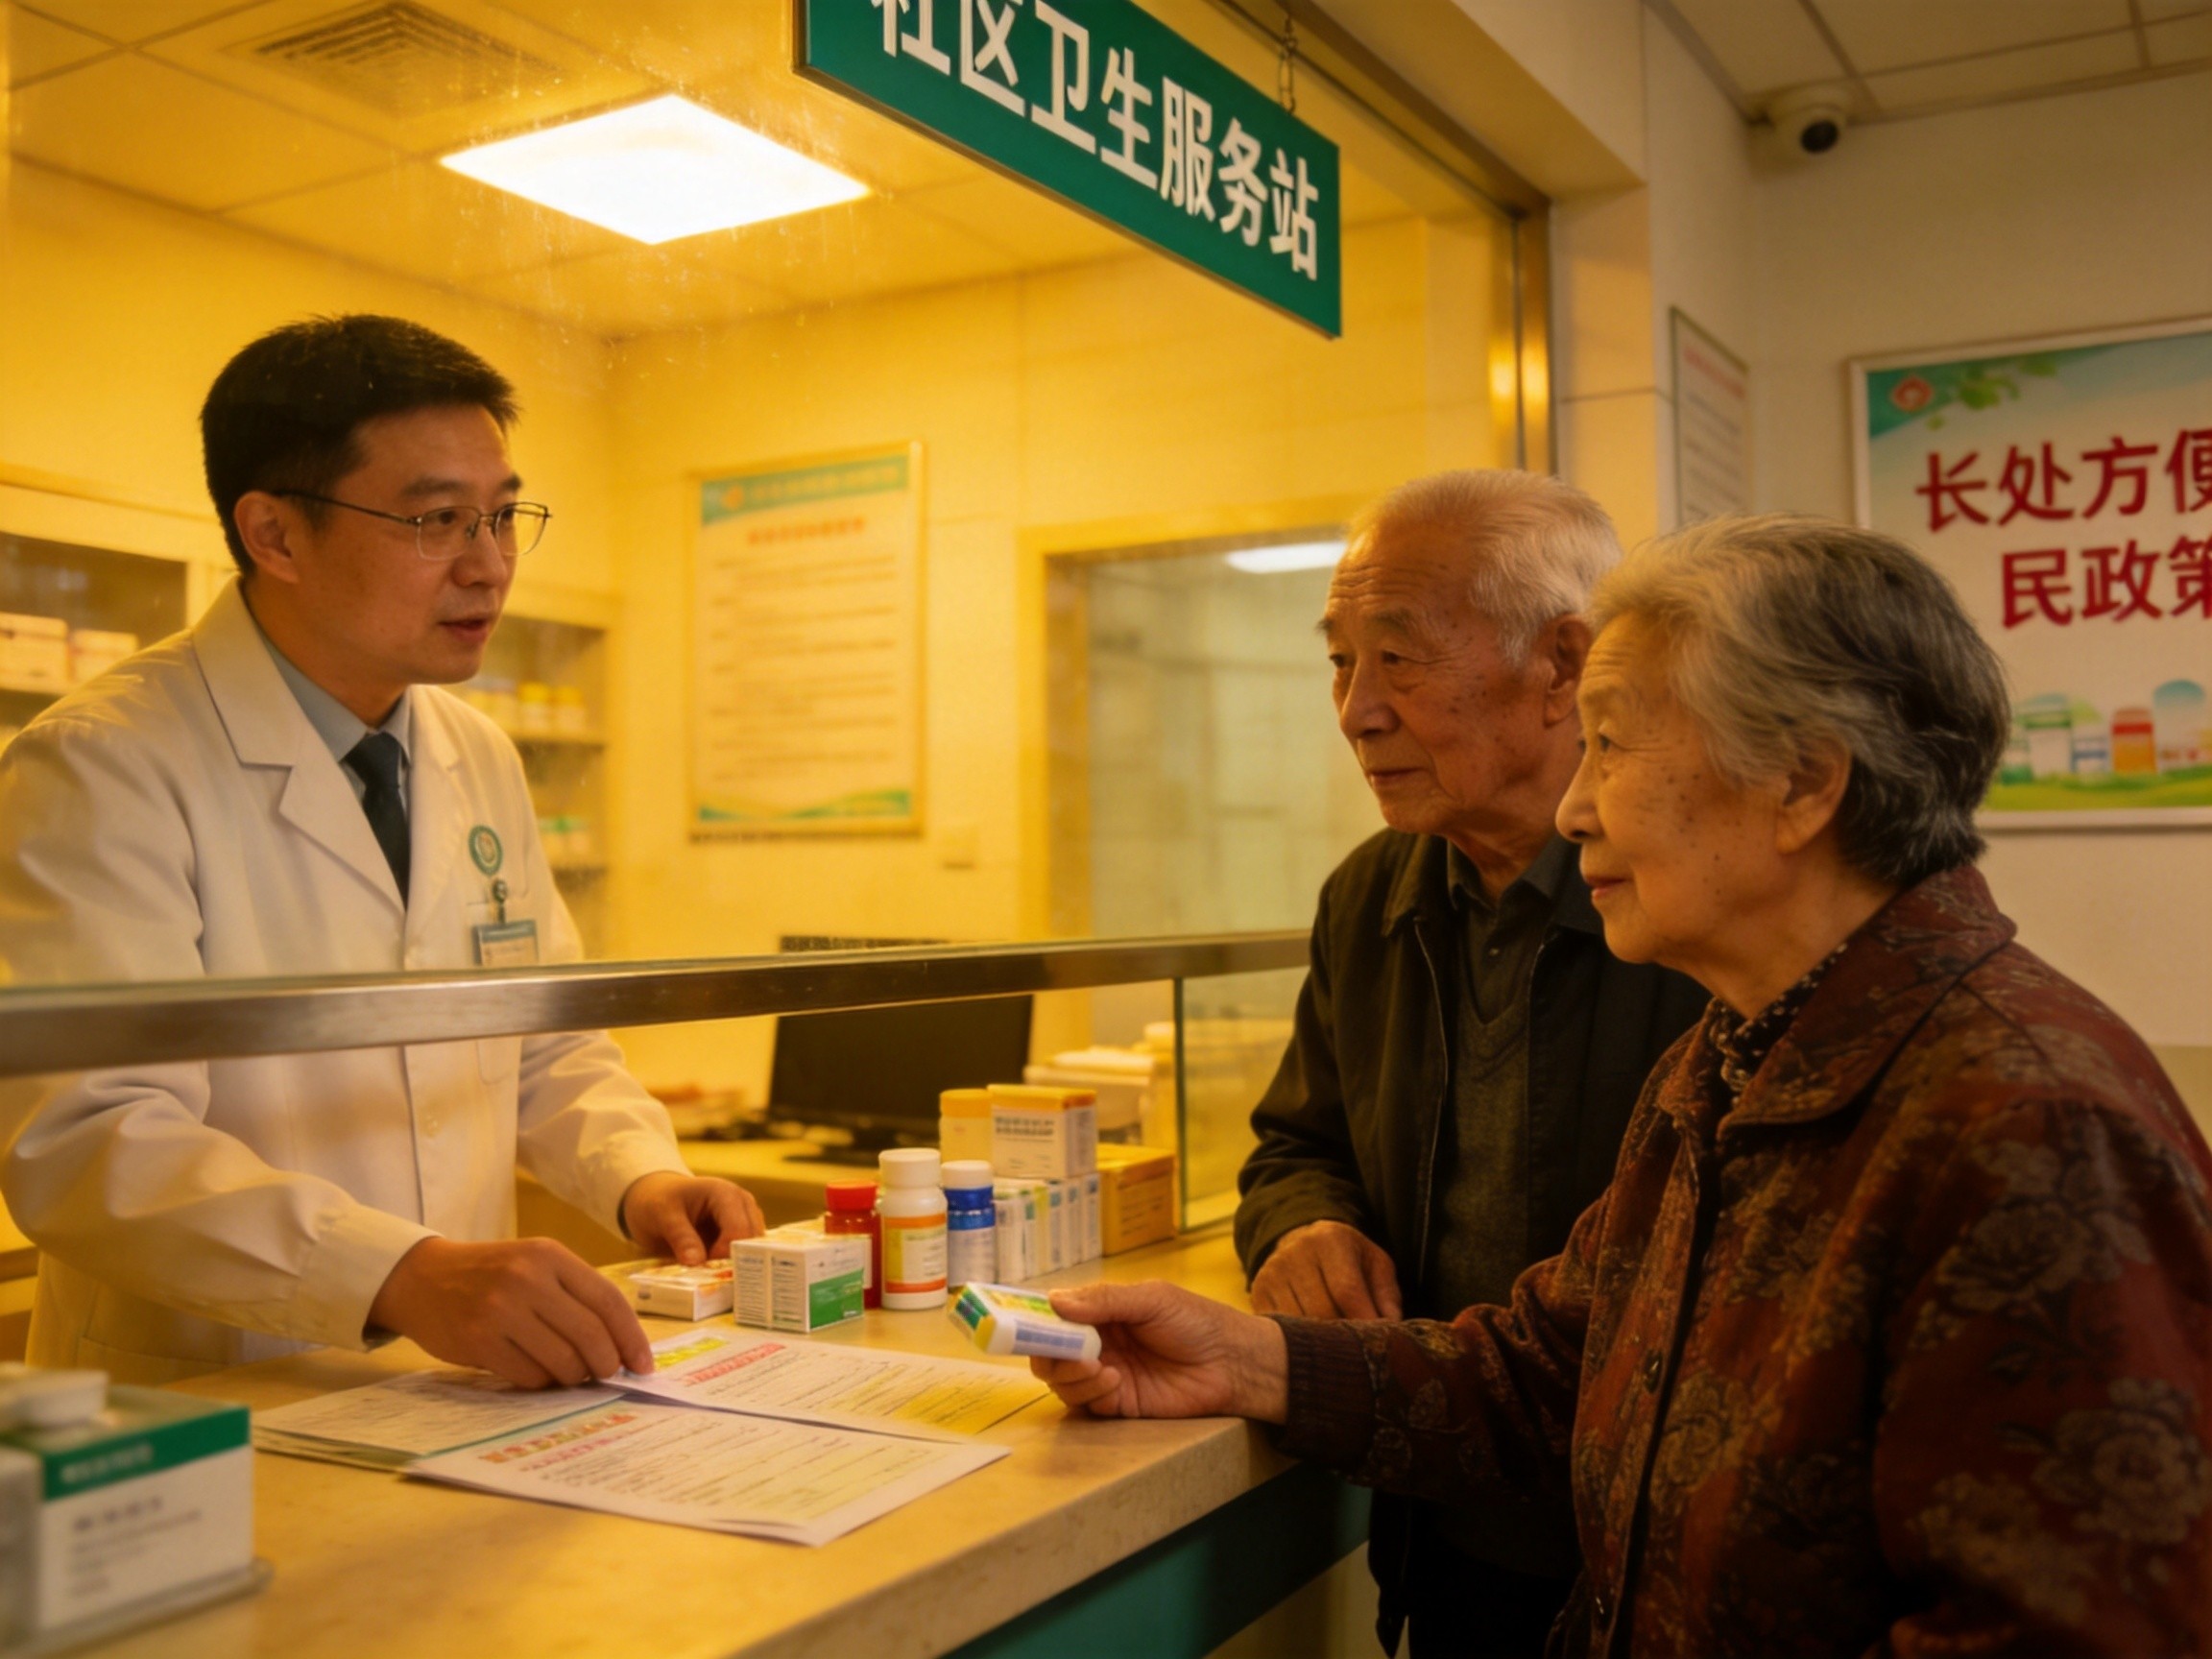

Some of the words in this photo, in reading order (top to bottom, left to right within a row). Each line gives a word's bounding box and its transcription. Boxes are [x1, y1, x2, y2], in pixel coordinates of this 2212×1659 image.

[1915, 428, 2212, 533] 长处方便
[2002, 530, 2212, 629] 民政策
